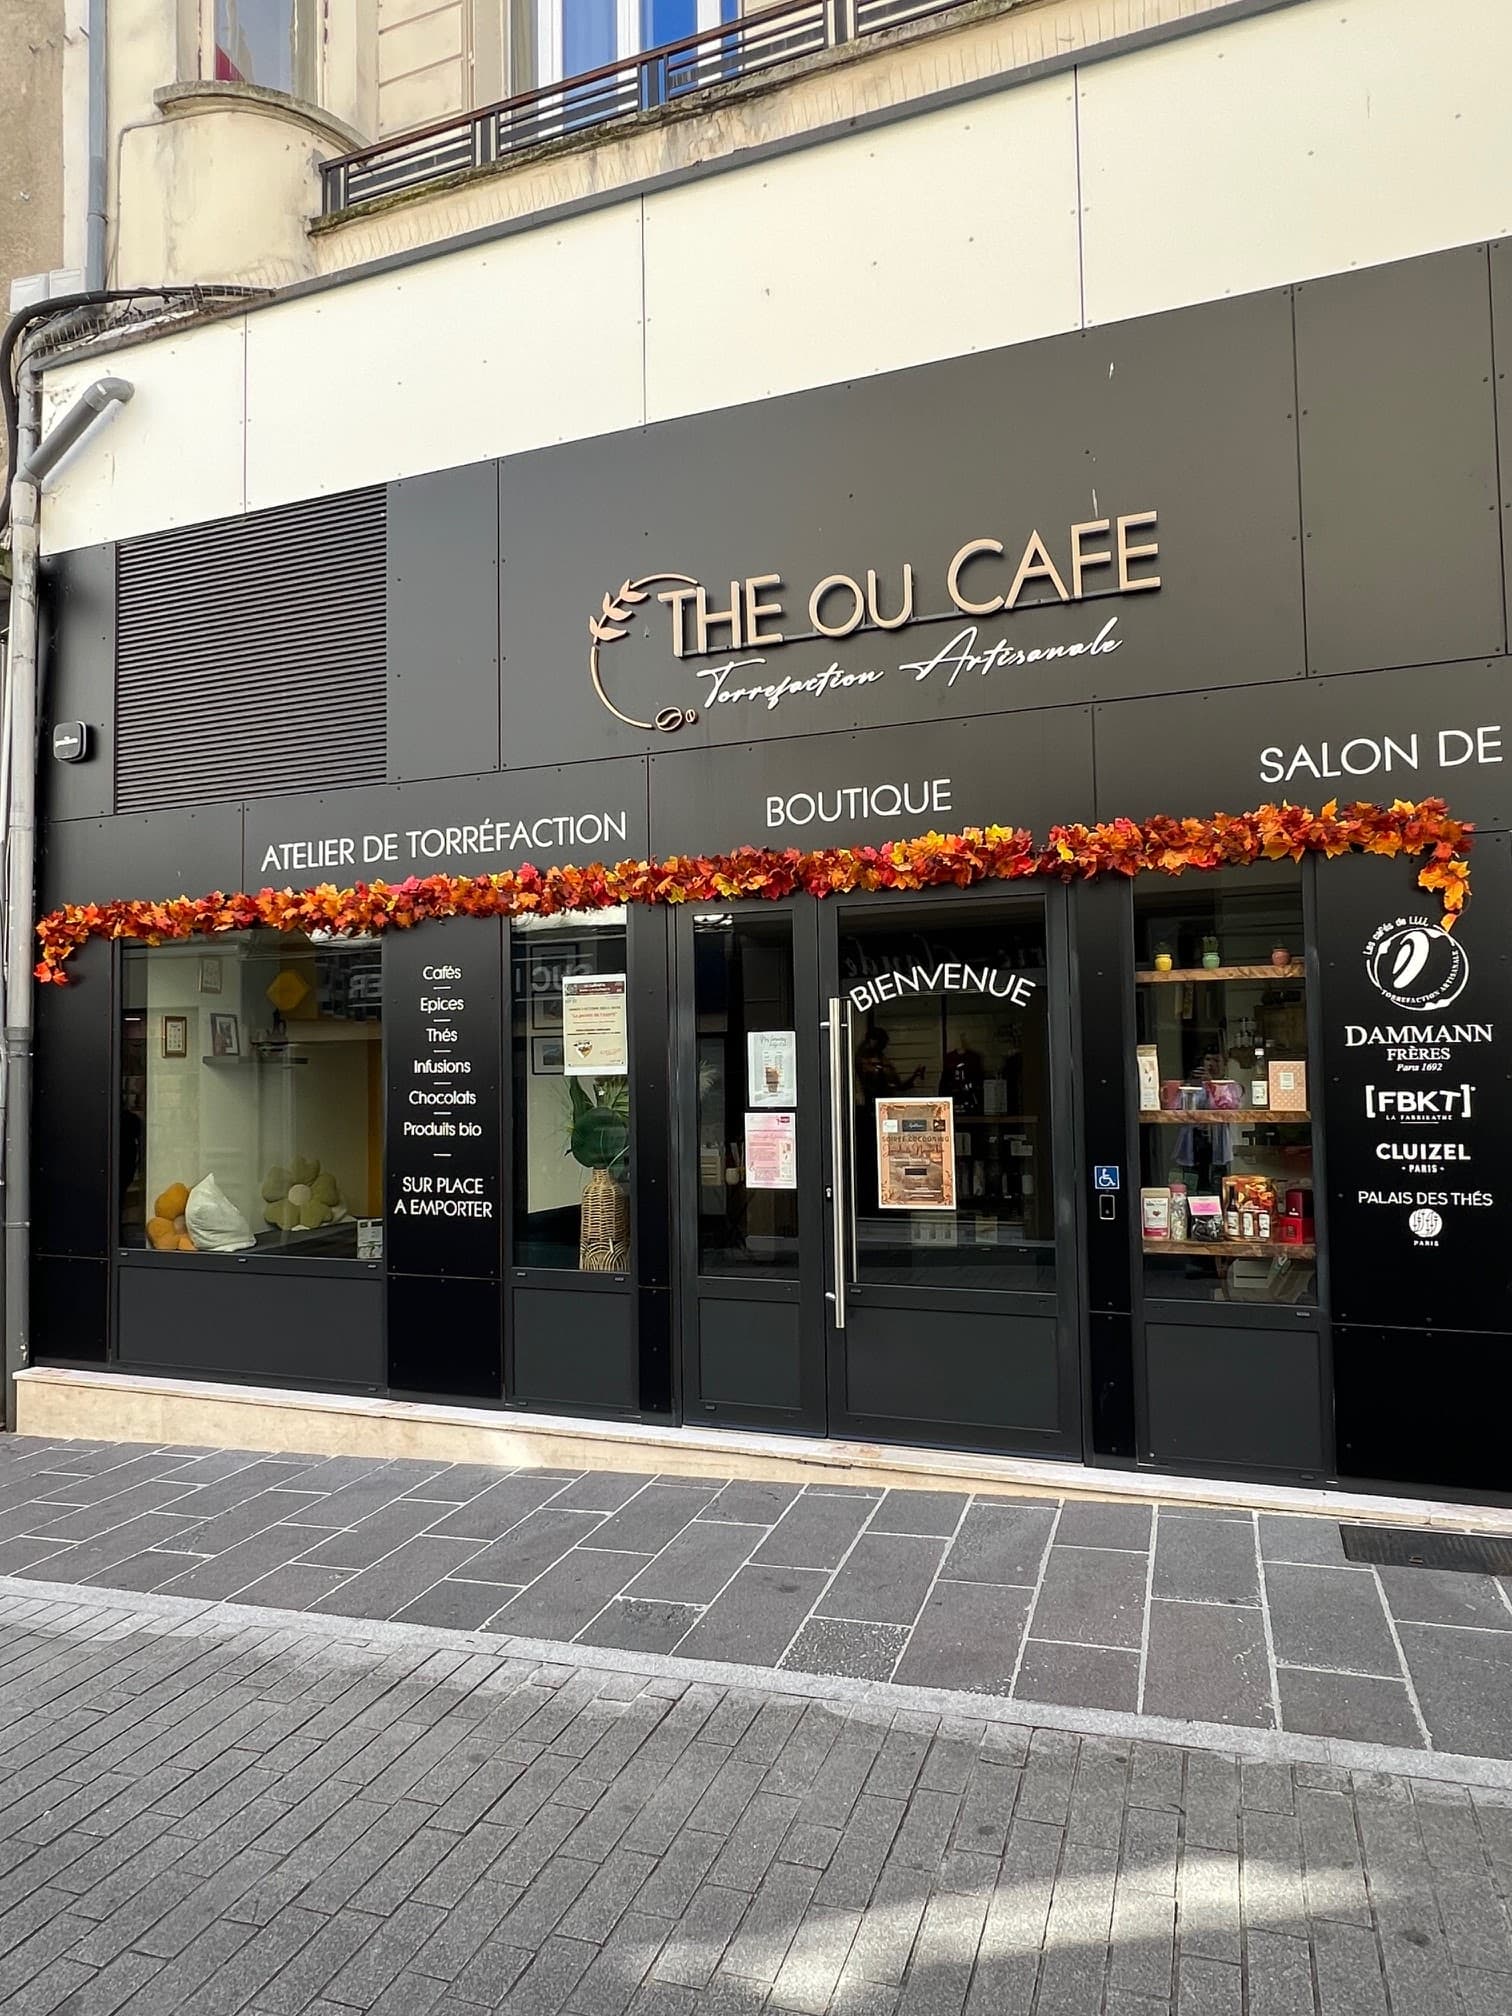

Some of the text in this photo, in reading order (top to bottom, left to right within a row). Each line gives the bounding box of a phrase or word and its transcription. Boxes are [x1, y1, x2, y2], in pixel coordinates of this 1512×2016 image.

[656, 510, 1162, 657] THE OU CAFE
[697, 616, 1123, 710] Torrefaction Artisanale
[1260, 725, 1503, 783] SALON DE
[766, 778, 952, 827] BOUTIQUE
[260, 811, 627, 872] ATELIER DE TORRÉFACTION
[422, 965, 462, 980] Cafés
[849, 963, 1036, 1012] BIENVENUE
[420, 996, 465, 1014] Epices
[425, 1027, 458, 1042] Thés
[1344, 1024, 1494, 1047] DAMMANN
[1386, 1045, 1451, 1061] FRÈRES
[414, 1059, 471, 1074] Infusions
[1396, 1062, 1443, 1072] Paris 1692
[408, 1090, 477, 1105] Chocolats
[403, 1121, 482, 1137] Produits bio
[1375, 1142, 1471, 1161] CLUIZEL
[1408, 1164, 1438, 1173] PARIS
[402, 1176, 484, 1195] SUR PLACE
[1358, 1190, 1494, 1207] PALAIS DES THÉS
[394, 1198, 493, 1218] A EMPORTER
[1413, 1240, 1439, 1248] PARIS
